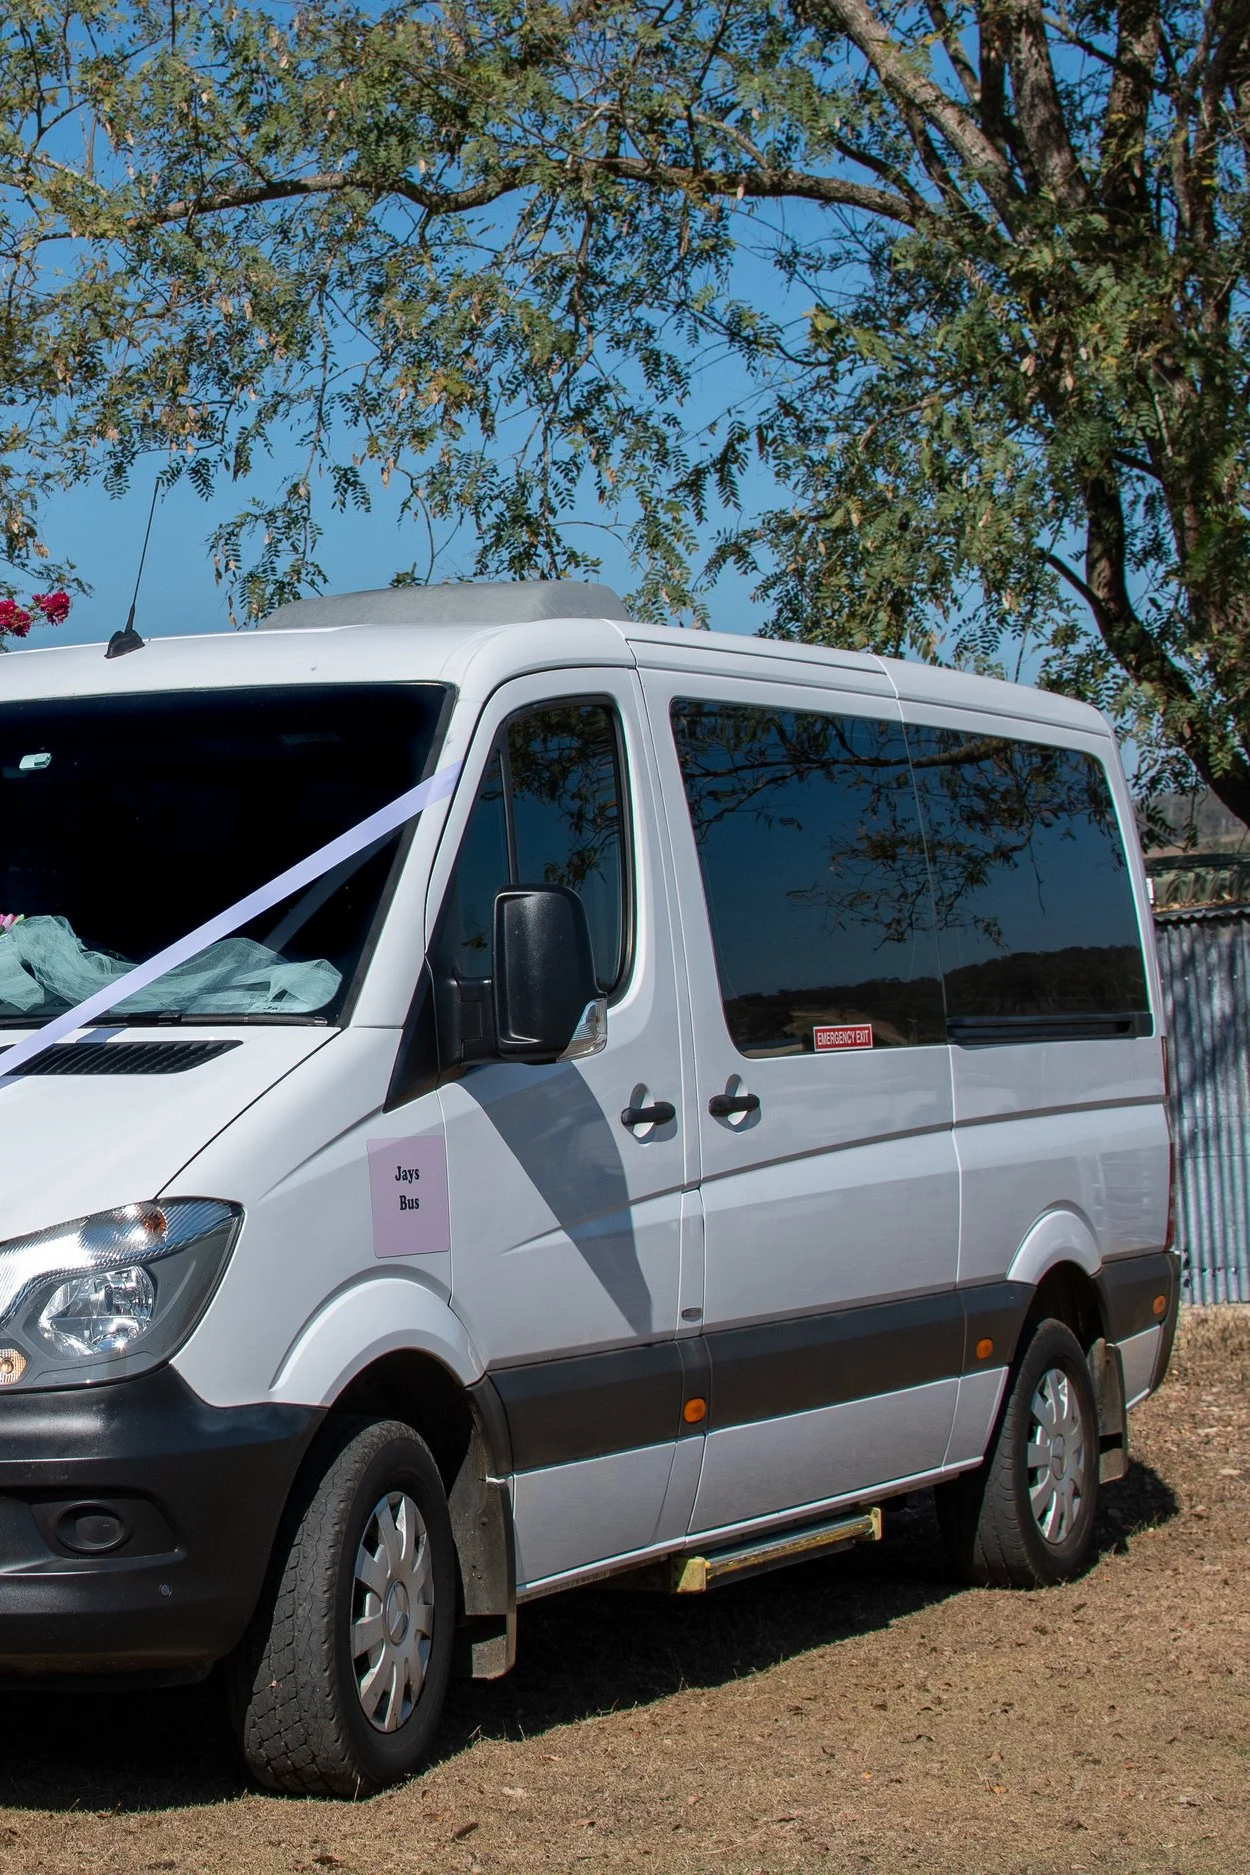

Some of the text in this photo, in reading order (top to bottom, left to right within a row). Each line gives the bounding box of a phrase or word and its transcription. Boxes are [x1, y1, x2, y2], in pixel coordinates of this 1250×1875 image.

[817, 1030, 869, 1045] EMERGENCY EXIT
[395, 1166, 420, 1184] Jays
[399, 1195, 420, 1211] Bus
